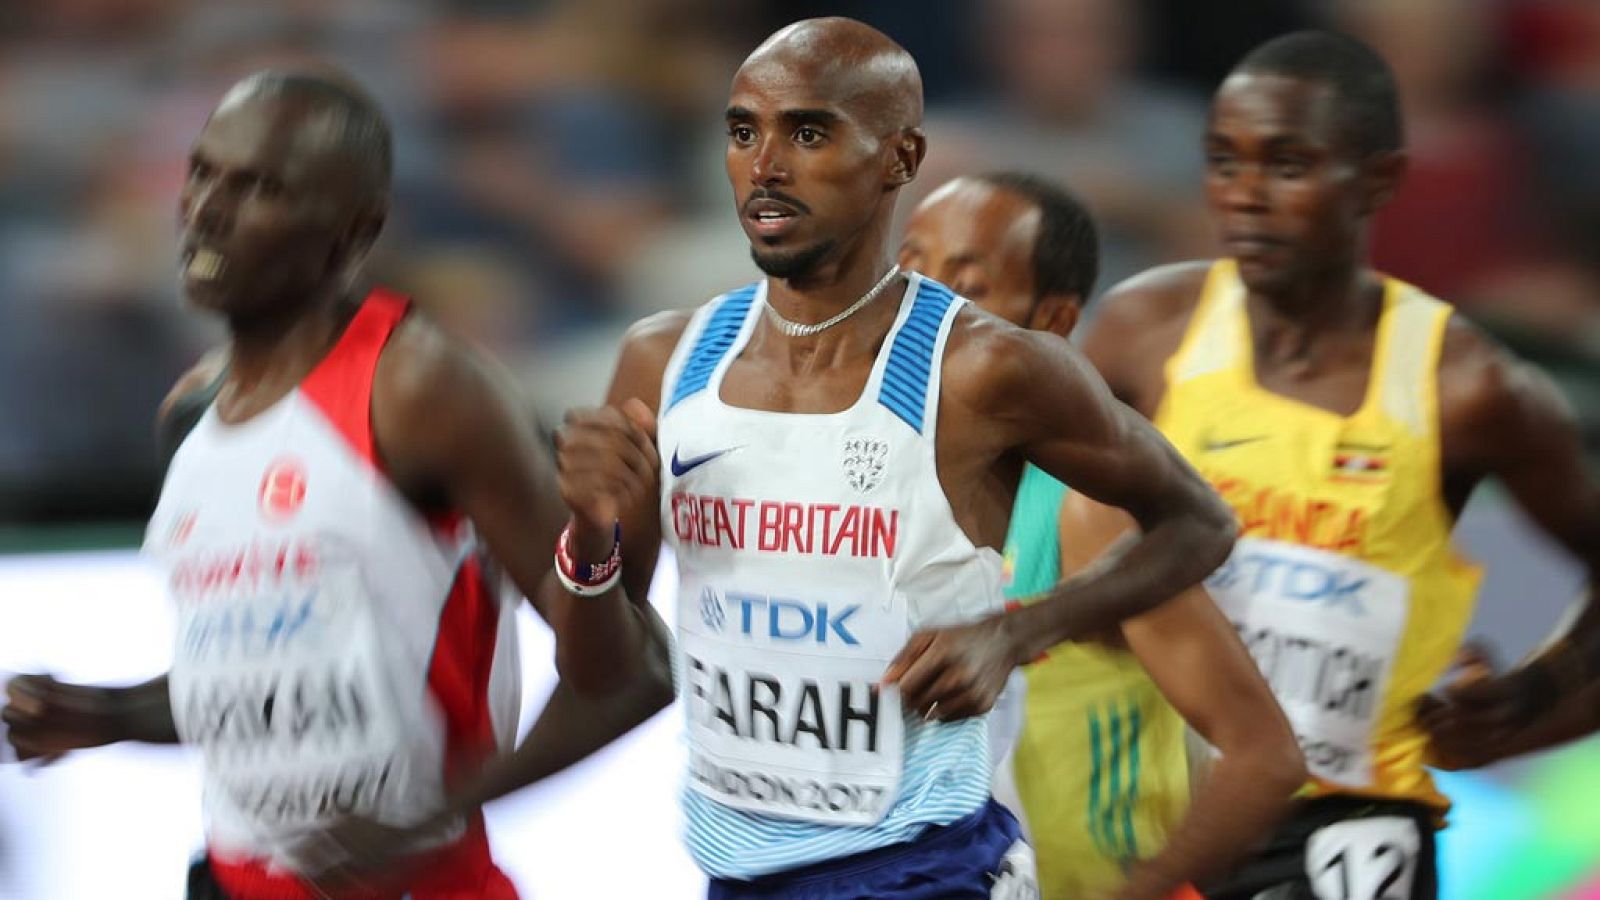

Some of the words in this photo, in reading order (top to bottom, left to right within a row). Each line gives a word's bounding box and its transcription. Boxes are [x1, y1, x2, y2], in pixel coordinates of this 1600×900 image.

[671, 492, 754, 549] GREAT
[758, 501, 899, 558] BRITAIN
[725, 590, 862, 645] TDK
[687, 653, 882, 752] FARAH
[1312, 842, 1407, 900] 12
